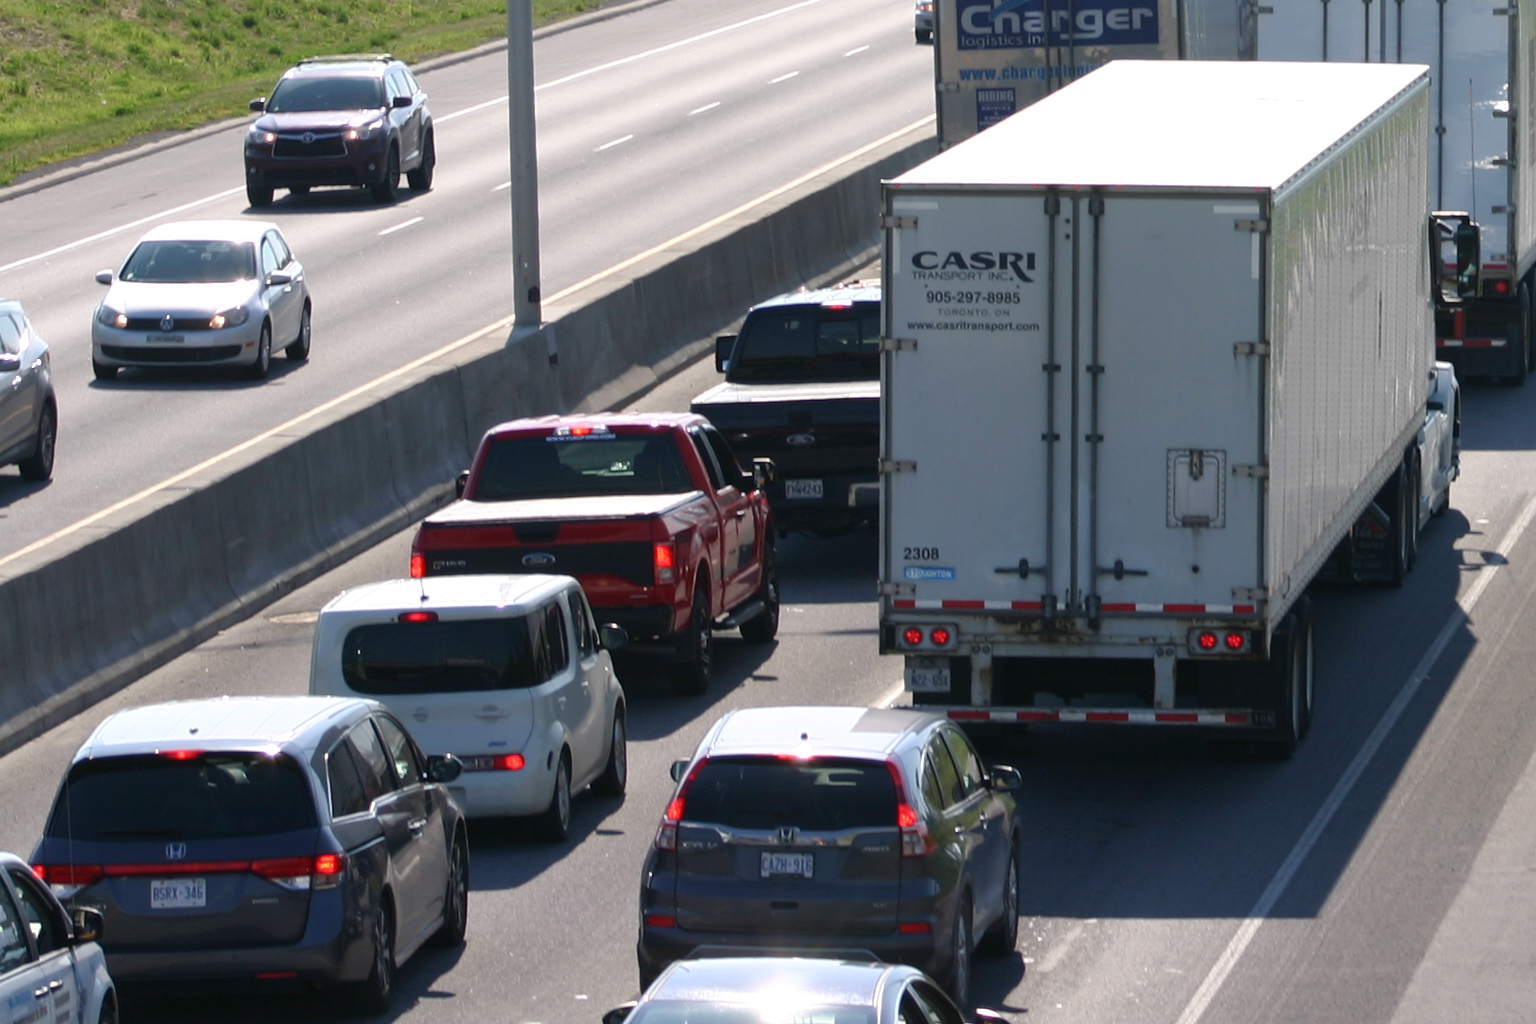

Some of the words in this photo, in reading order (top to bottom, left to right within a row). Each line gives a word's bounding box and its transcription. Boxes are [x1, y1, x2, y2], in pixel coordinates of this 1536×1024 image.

[962, 37, 1023, 48] logistics
[978, 90, 1015, 103] HIRING
[911, 251, 1036, 283] CASRI
[912, 271, 983, 281] TRANSPORT
[926, 291, 1021, 304] 905-297-8985
[994, 309, 1011, 317] ON
[907, 321, 1040, 332] www.casritransport.com
[903, 547, 940, 561] 2308
